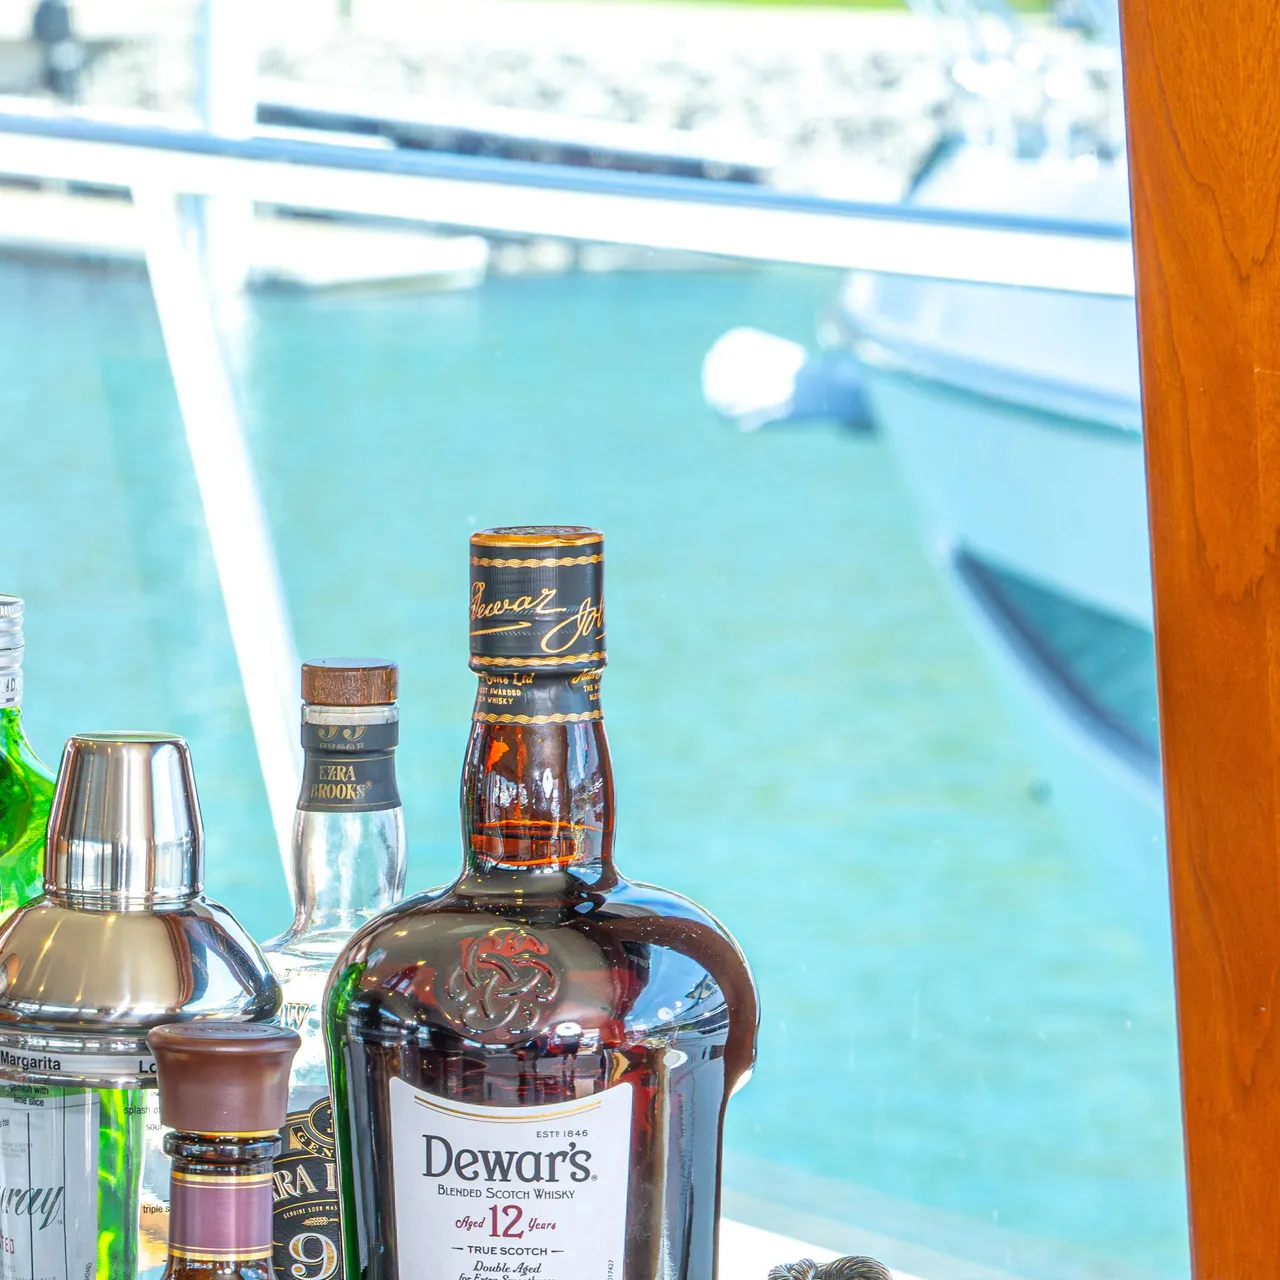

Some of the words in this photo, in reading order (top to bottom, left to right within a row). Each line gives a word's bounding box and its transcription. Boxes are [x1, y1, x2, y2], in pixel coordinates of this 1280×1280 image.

[490, 687, 522, 697] AWARDED
[487, 697, 514, 705] WHISKY
[319, 765, 356, 782] EZRA
[310, 782, 366, 800] BROOKS
[0, 1050, 61, 1071] Margarita
[124, 1105, 151, 1115] splash
[563, 1129, 588, 1138] 1846
[422, 1134, 592, 1183] Dewar's
[142, 1205, 163, 1214] triple
[282, 1208, 306, 1219] GENUINE
[307, 1205, 324, 1213] SOUR
[455, 1216, 486, 1231] Aged
[488, 1204, 524, 1239] 12
[528, 1218, 556, 1231] Years
[467, 1246, 498, 1255] TRUE
[499, 1247, 548, 1256] SCOTCH
[472, 1260, 512, 1273] Double
[512, 1263, 542, 1277] Aged
